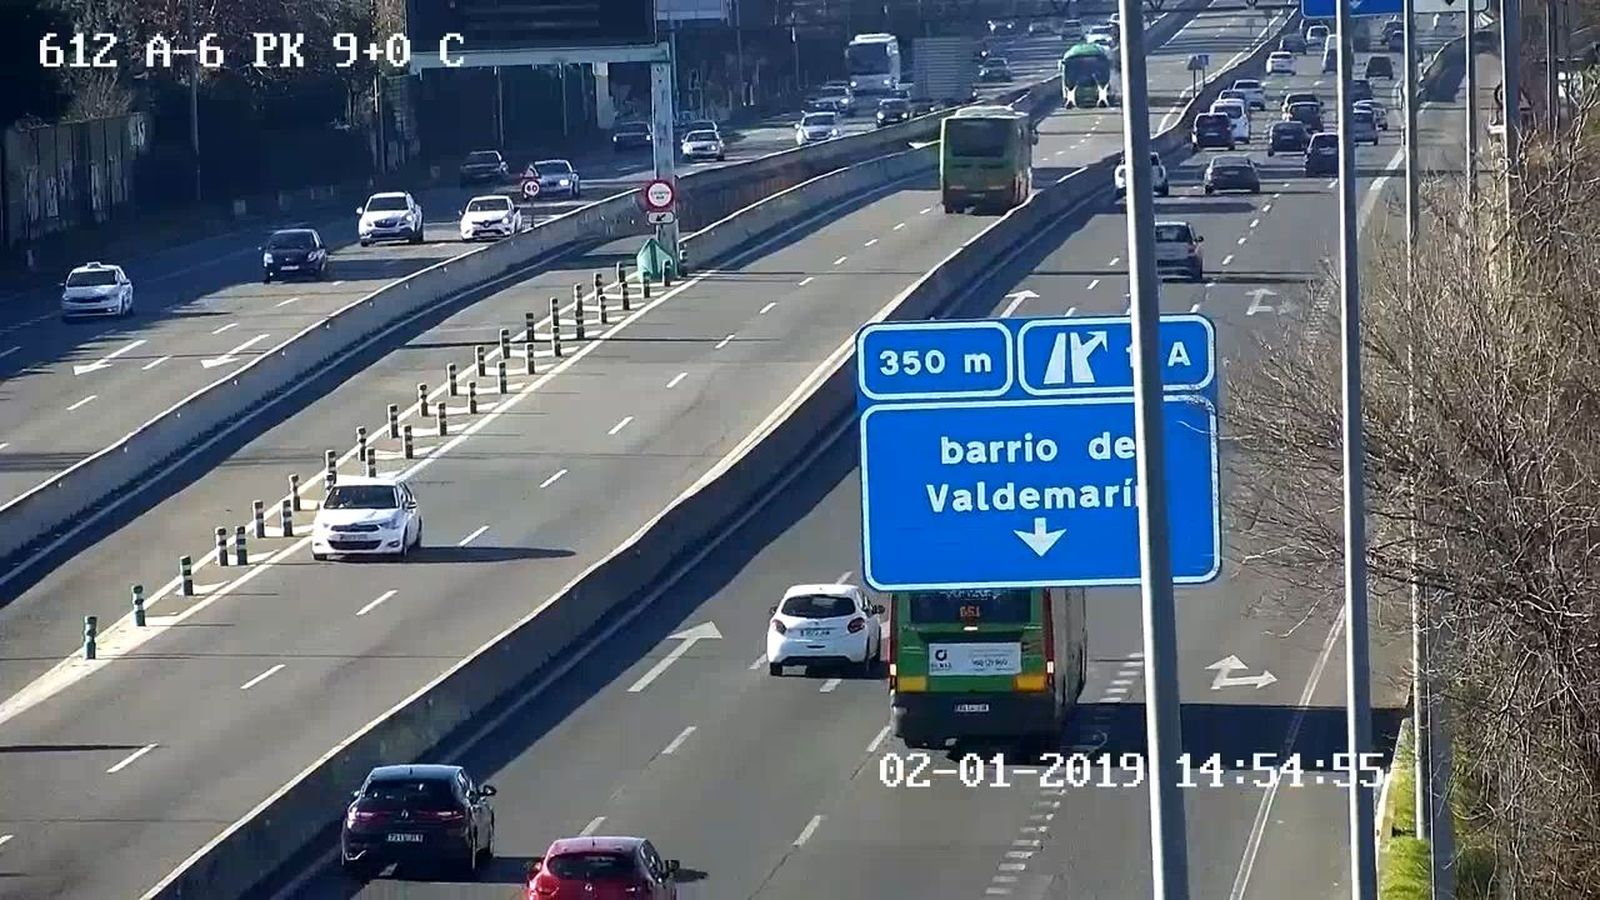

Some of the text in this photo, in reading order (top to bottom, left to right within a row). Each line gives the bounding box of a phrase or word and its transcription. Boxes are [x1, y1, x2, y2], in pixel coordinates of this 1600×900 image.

[879, 350, 992, 376] 350 m
[1167, 341, 1191, 367] A
[940, 432, 1136, 465] barrio de
[926, 478, 1142, 513] Valdemarí
